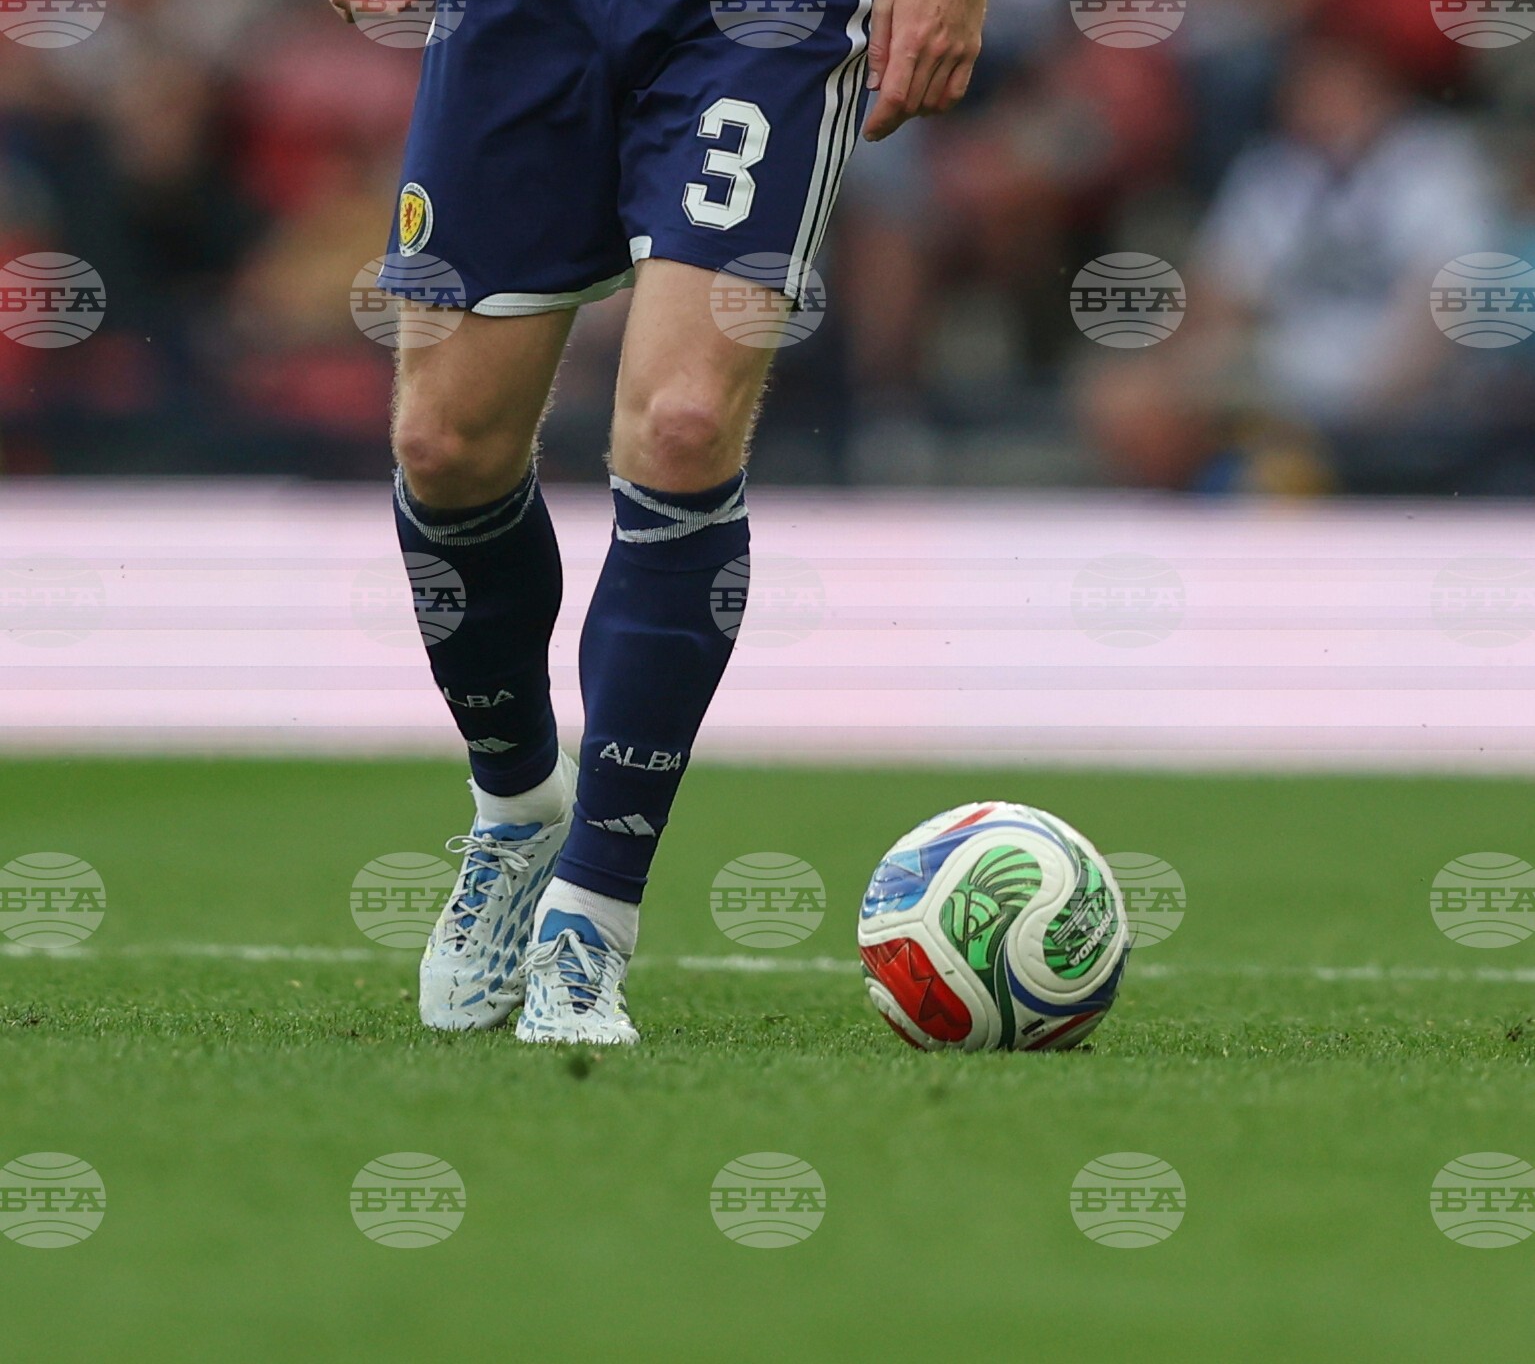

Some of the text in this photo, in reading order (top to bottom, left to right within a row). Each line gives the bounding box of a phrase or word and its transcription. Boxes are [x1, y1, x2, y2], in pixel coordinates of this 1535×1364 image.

[682, 97, 770, 231] 3
[444, 687, 515, 708] LBA
[600, 742, 681, 771] ALBA
[1068, 909, 1114, 966] TRIONDA
